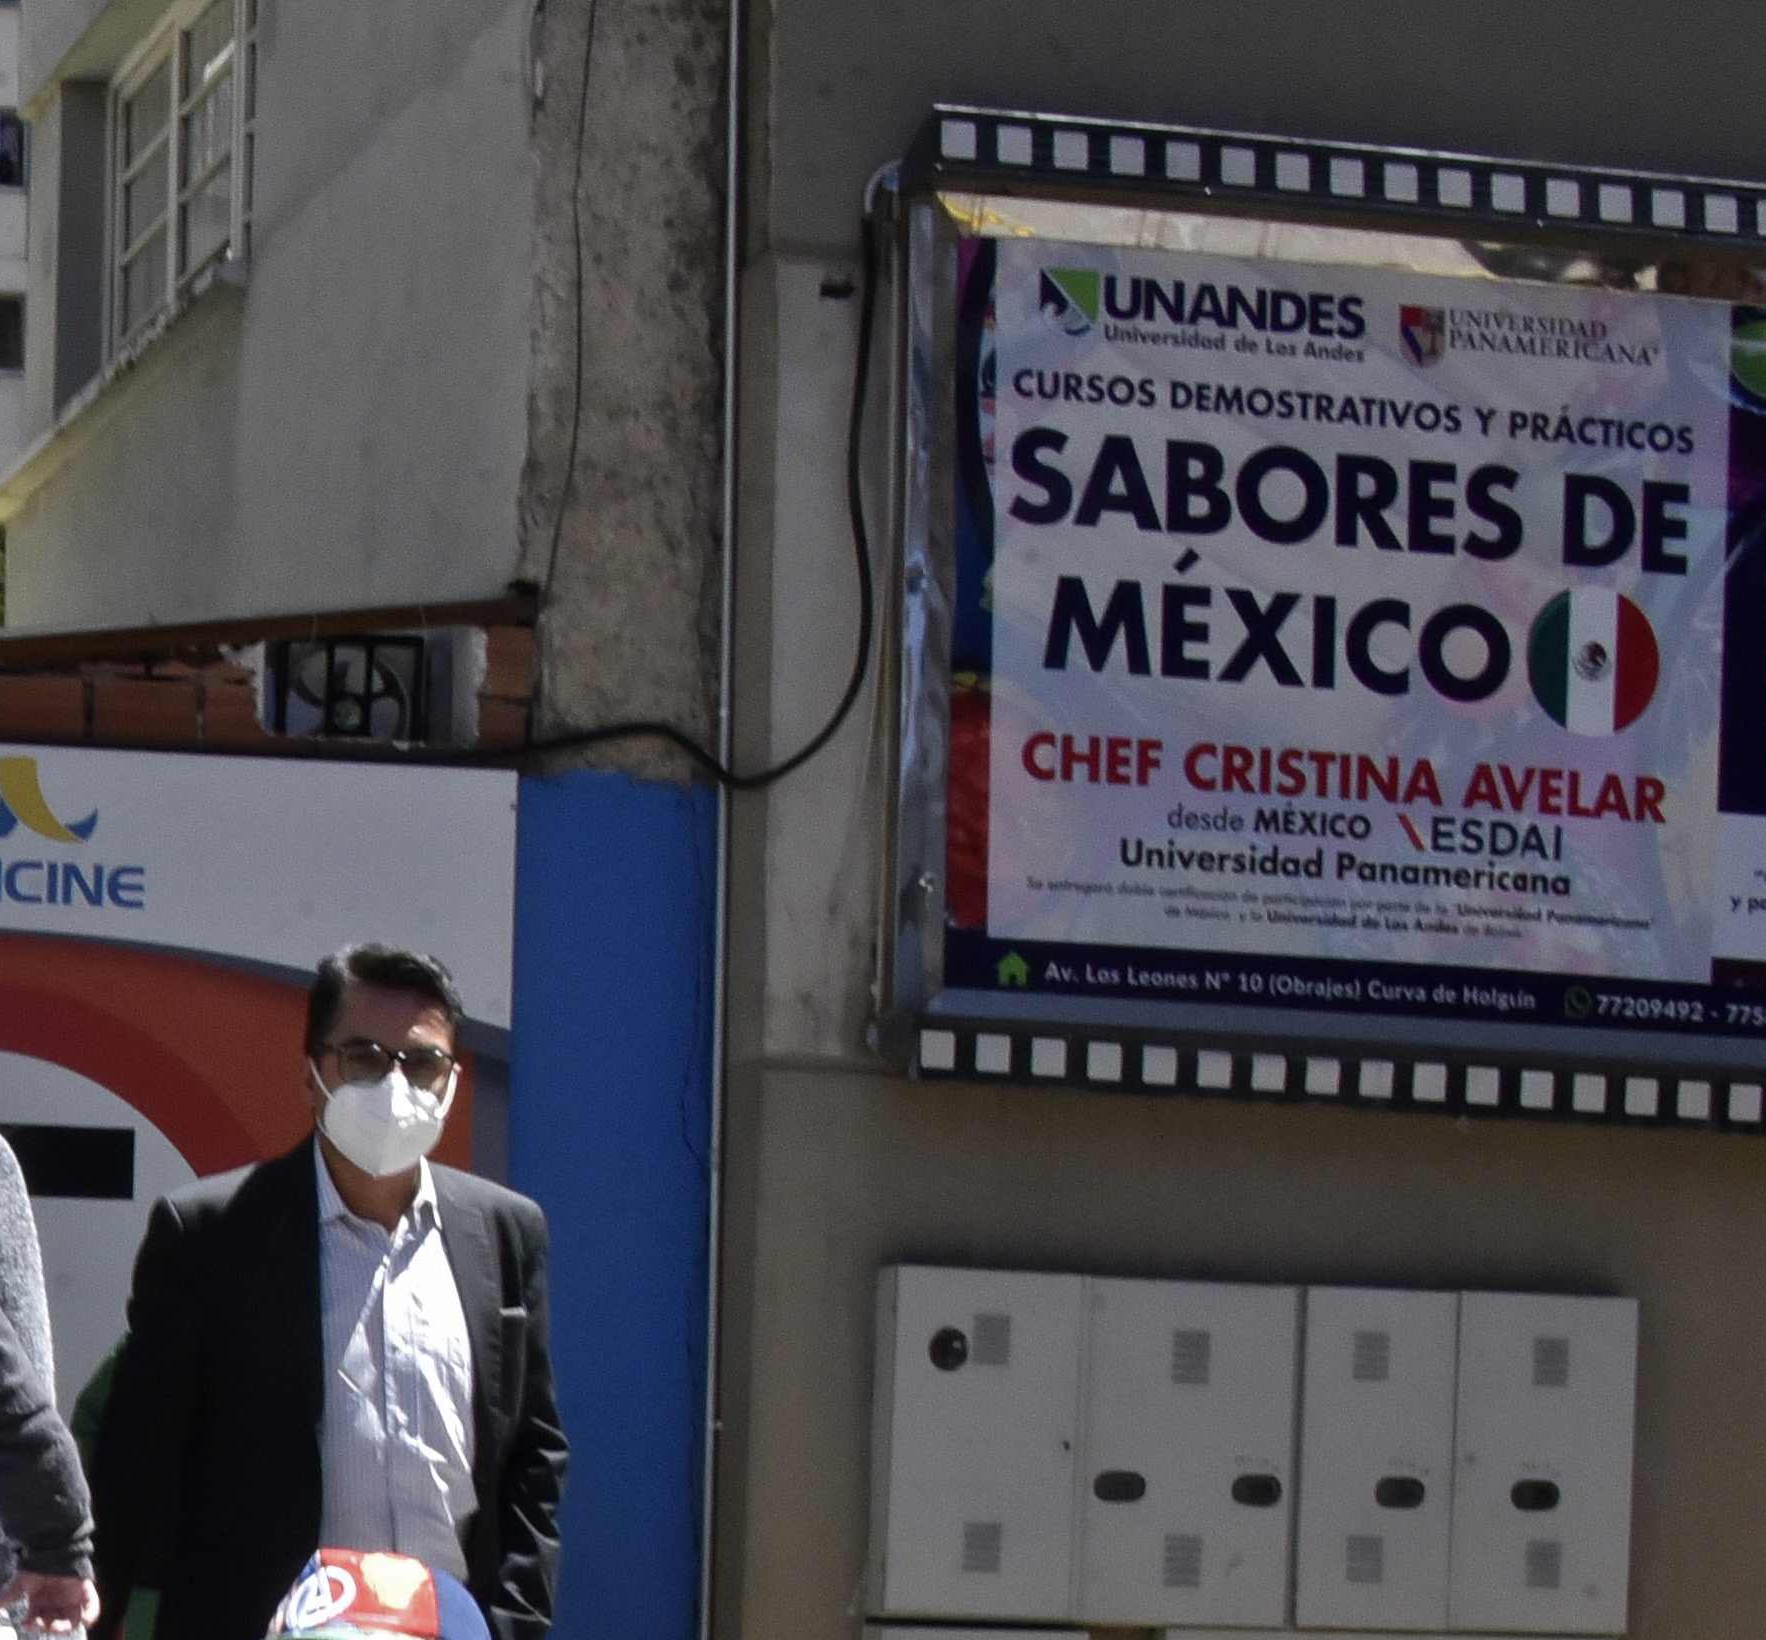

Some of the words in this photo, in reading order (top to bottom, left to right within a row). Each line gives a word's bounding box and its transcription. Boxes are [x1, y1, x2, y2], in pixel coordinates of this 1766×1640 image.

[1104, 274, 1365, 339] UNANDES
[1449, 308, 1607, 341] UNIVERSIDAD
[1104, 323, 1226, 353] Universidad
[1234, 334, 1258, 353] de
[1266, 338, 1297, 357] Los
[1303, 342, 1364, 363] Andes
[1012, 368, 1156, 408] CURSOS
[1170, 380, 1461, 434] DEMOSTRATIVOS
[1474, 406, 1496, 436] Y
[1508, 405, 1694, 454] PRÁCTICOS
[1009, 425, 1524, 563] SABORES
[1562, 472, 1691, 577] DE
[1042, 547, 1512, 703] MÉXICO
[1021, 730, 1163, 787] CHEF
[1183, 741, 1443, 807] CRISTINA
[1463, 761, 1666, 824] AVELAR
[1168, 802, 1244, 833] desde
[1253, 801, 1372, 841] MÉXICO
[1430, 815, 1563, 862] ESDAI
[1120, 837, 1324, 880] Universidad
[1336, 851, 1572, 896] Panamericana
[1044, 960, 1078, 983] Av.
[1085, 963, 1118, 985] Los
[1127, 965, 1197, 990] Leones
[1238, 972, 1264, 993] 10
[1269, 974, 1361, 1002] (Obrajes)
[1367, 979, 1427, 1002] Curva
[1432, 982, 1457, 1003] de
[1596, 994, 1704, 1022] 77209492
